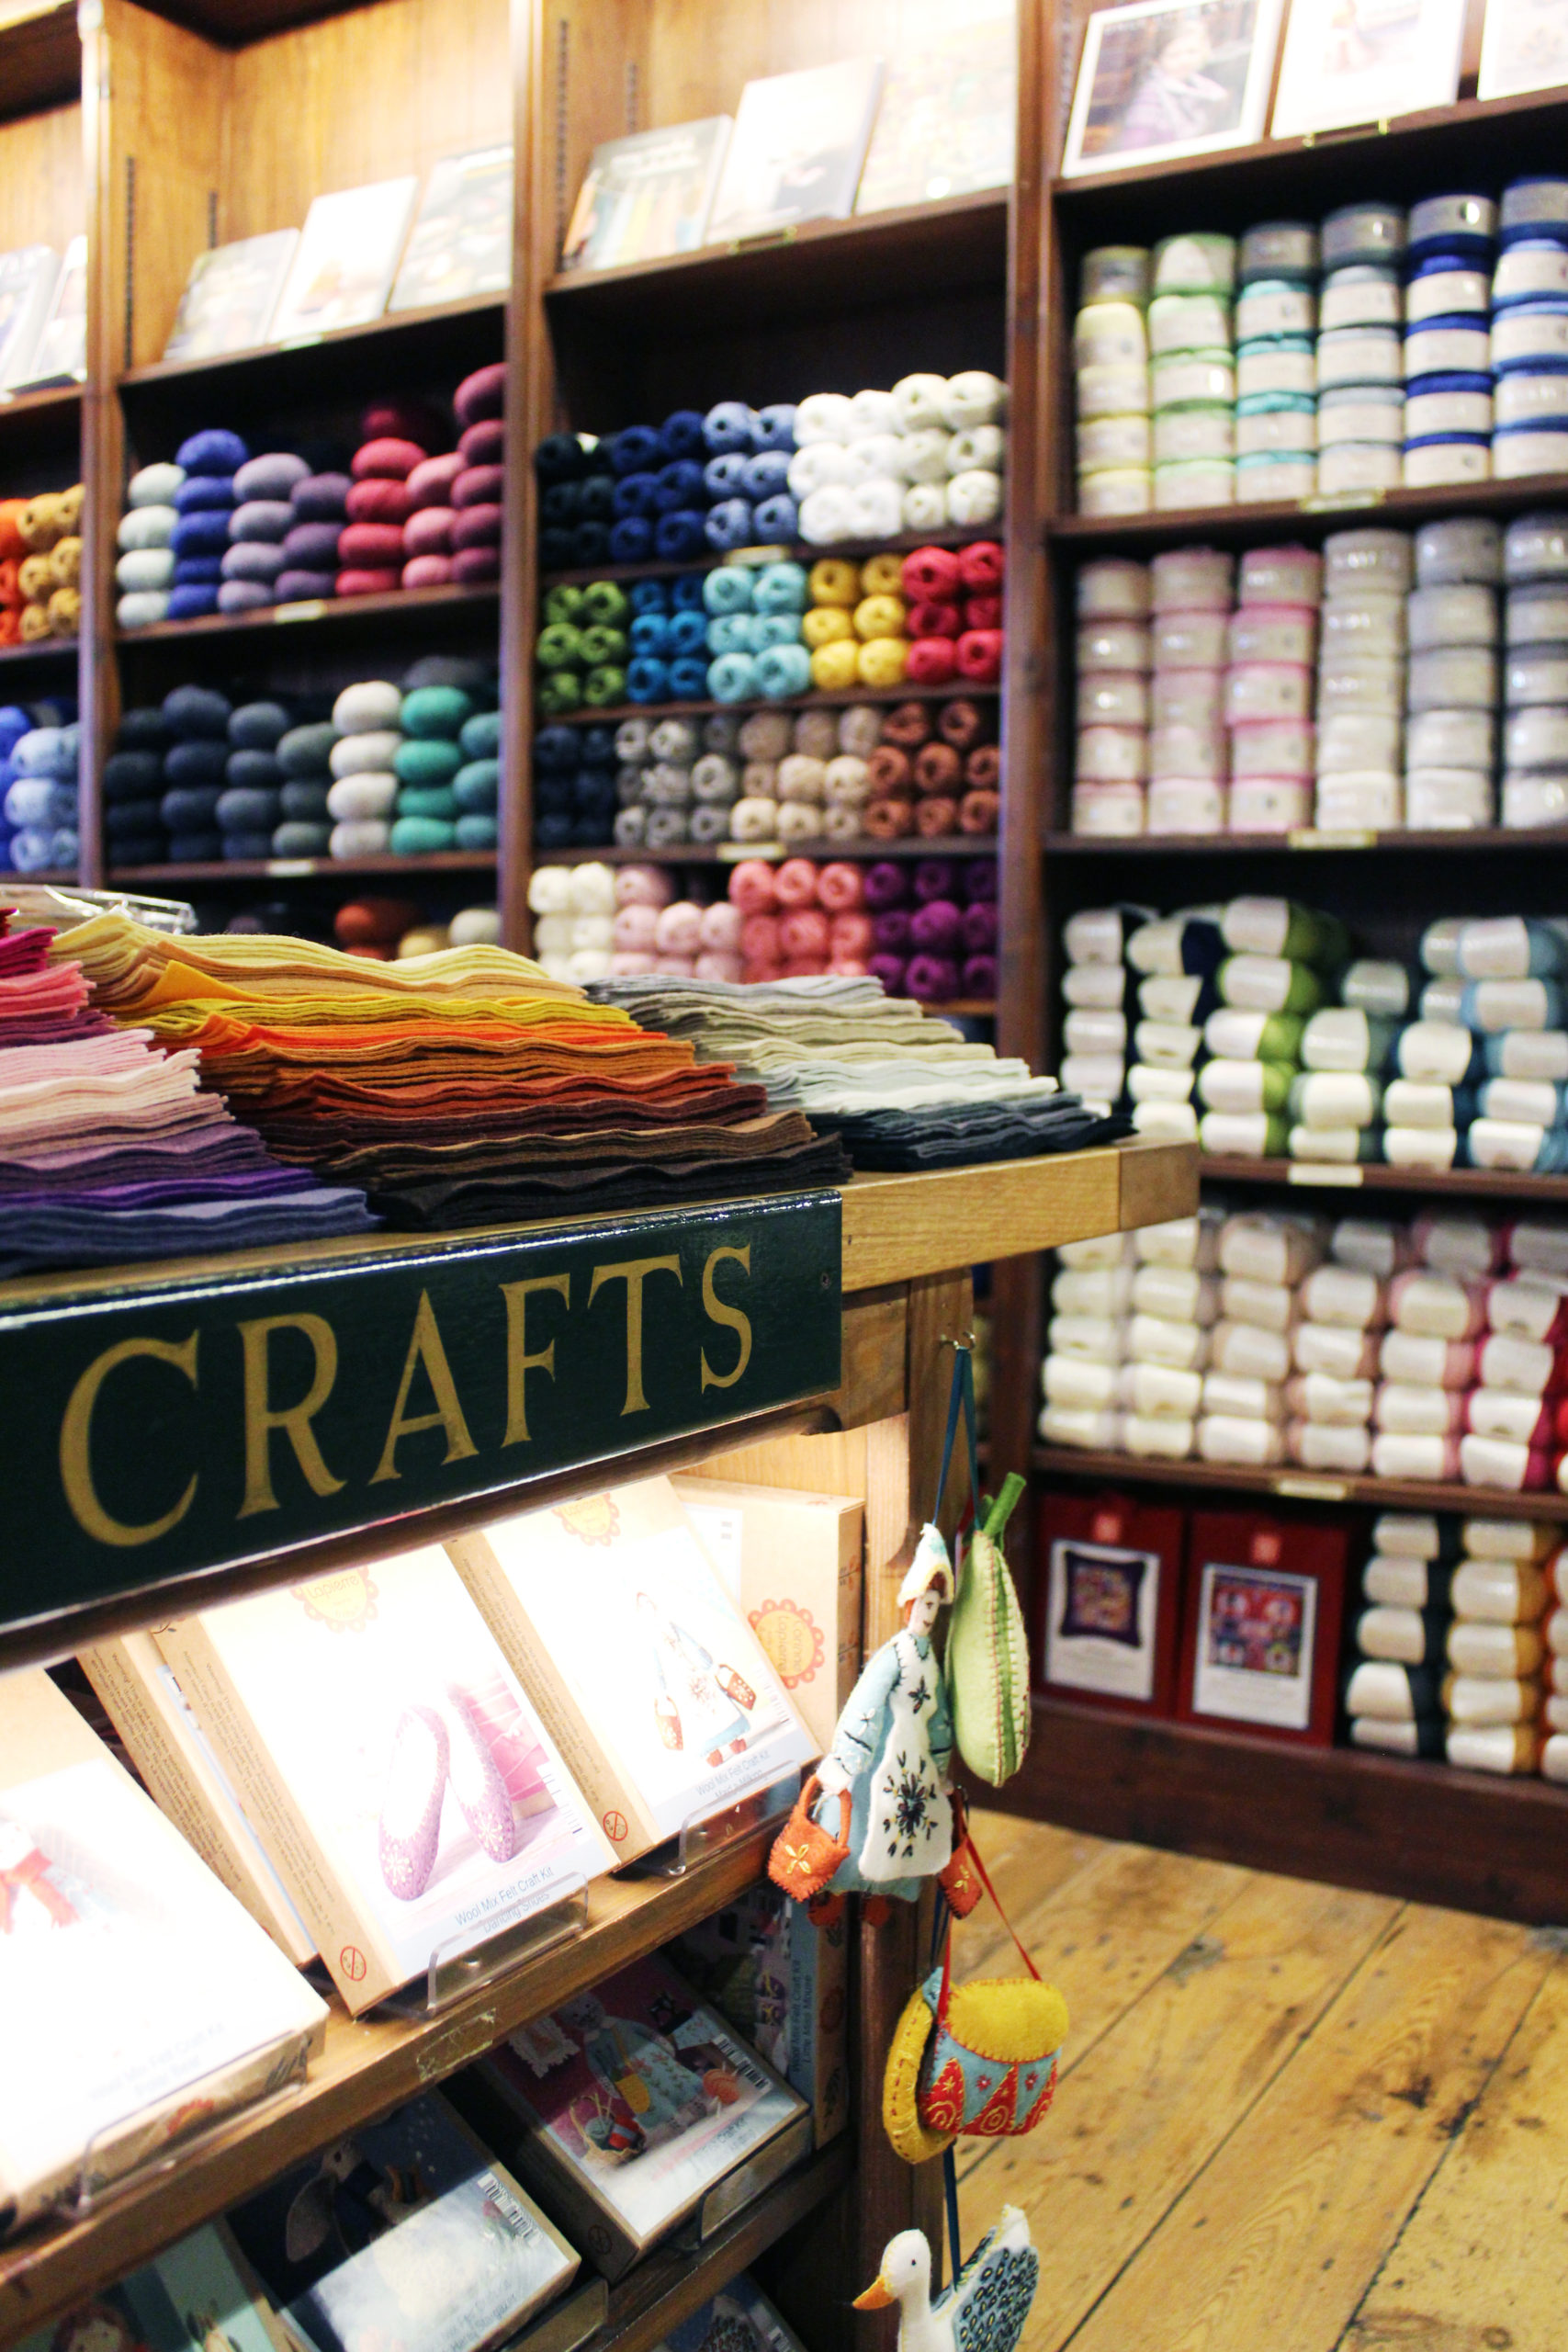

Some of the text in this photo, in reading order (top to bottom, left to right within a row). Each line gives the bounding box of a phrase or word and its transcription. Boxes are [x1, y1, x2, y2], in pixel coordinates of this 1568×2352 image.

[60, 1245, 753, 1546] CRAFTS
[307, 1576, 359, 1599] Lapierre
[455, 1867, 555, 1926] Wool Mix Felt Craft Kit
[483, 1893, 550, 1933] Dancing Shoes
